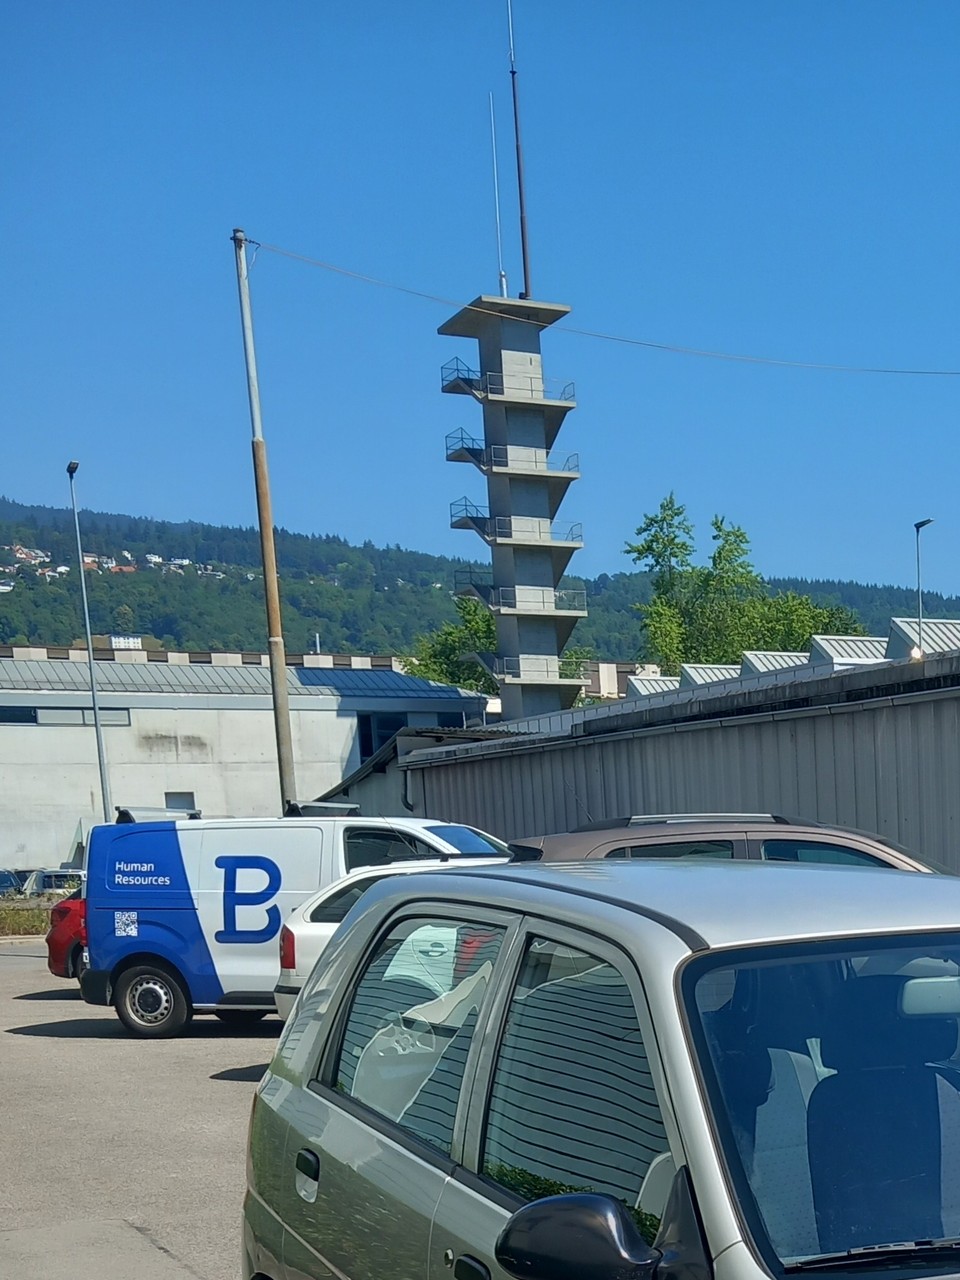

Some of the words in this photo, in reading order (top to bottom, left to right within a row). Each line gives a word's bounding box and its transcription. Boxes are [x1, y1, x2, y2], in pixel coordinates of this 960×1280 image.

[115, 861, 155, 871] Human
[115, 874, 171, 885] Resources
[214, 855, 282, 944] B
